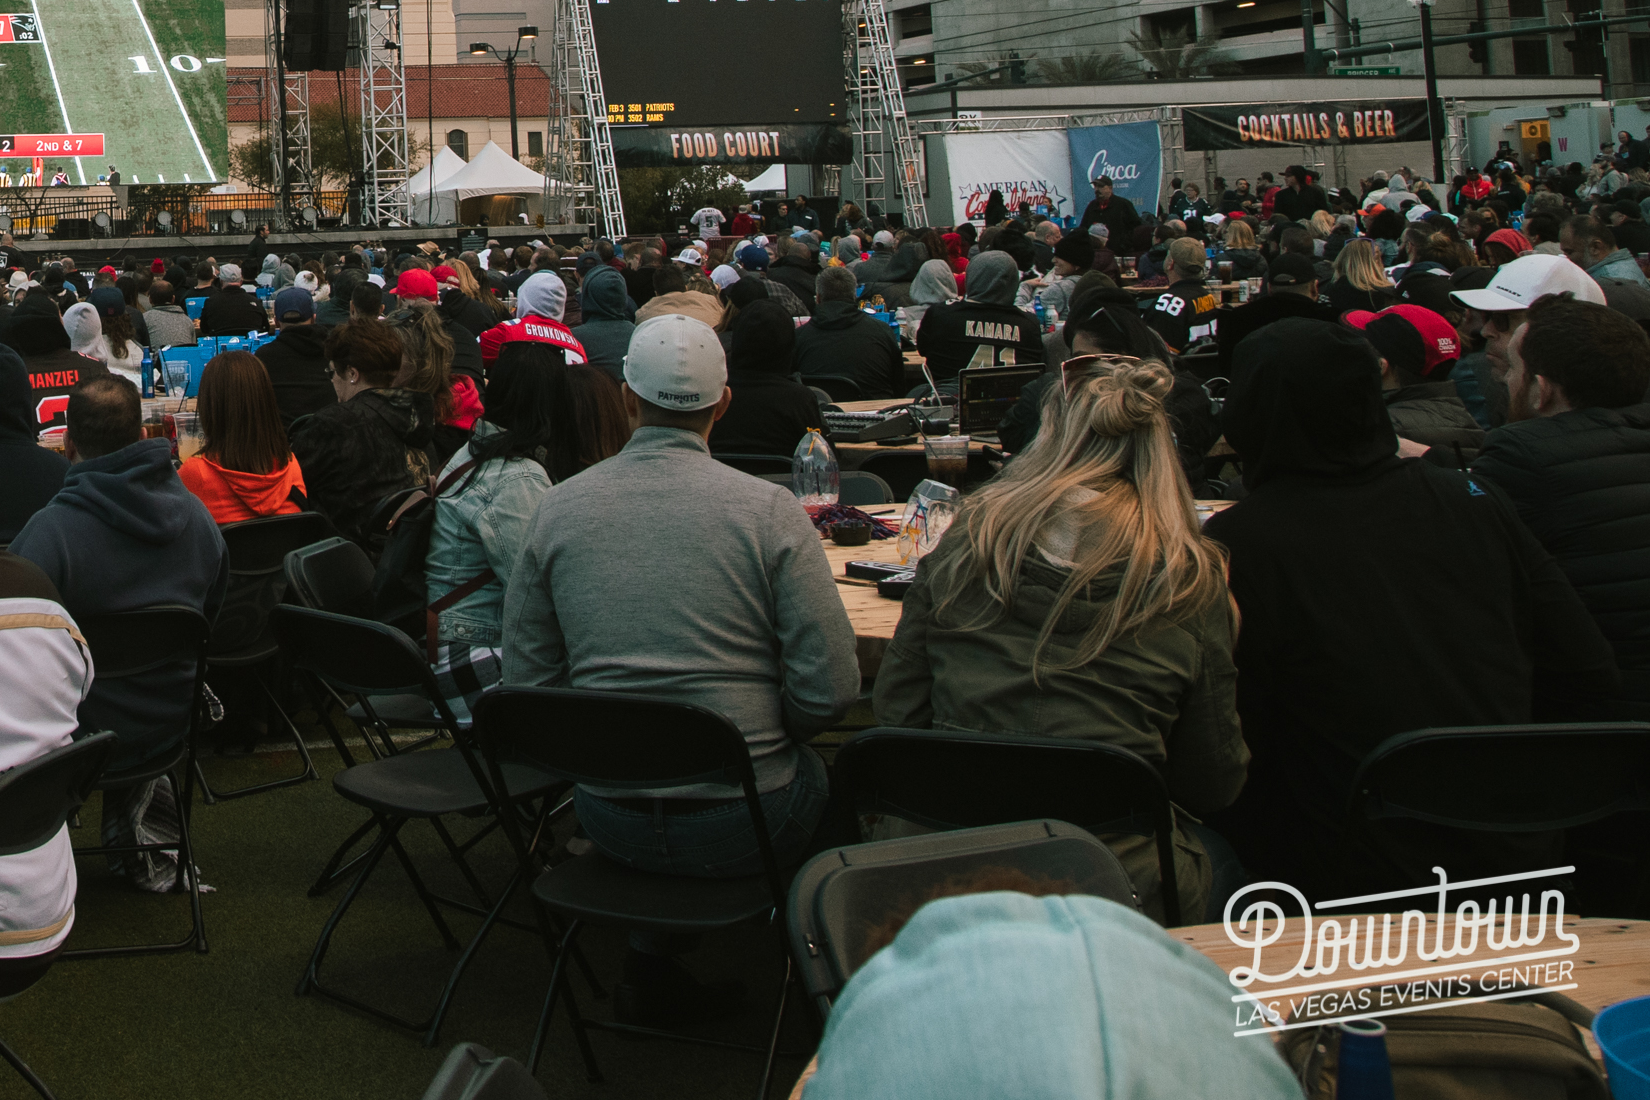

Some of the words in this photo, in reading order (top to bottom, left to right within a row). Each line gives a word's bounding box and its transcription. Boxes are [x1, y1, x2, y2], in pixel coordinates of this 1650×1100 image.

[128, 54, 203, 74] 10
[608, 104, 619, 112] FEB
[620, 104, 625, 112] 3
[628, 103, 642, 112] 3501
[646, 102, 675, 112] PATRIOTS
[615, 114, 625, 122] PM
[628, 113, 643, 122] 3502
[646, 113, 664, 122] RAMS
[1237, 111, 1331, 143] COCKTAILS
[1336, 112, 1349, 138] &
[1353, 109, 1396, 138] BEER
[1, 140, 11, 152] 2
[36, 140, 59, 151] 2ND
[63, 140, 72, 151] &
[74, 140, 83, 151] 7
[670, 132, 718, 159] FOOD
[724, 131, 780, 157] COURT
[1558, 137, 1568, 152] W
[1087, 149, 1141, 189] Circa
[975, 180, 1047, 195] AMERICAN
[1154, 293, 1185, 316] 58
[524, 322, 579, 348] GRONKOWSKI
[965, 320, 1021, 342] KAMARA
[657, 390, 700, 404] PATRIOTS
